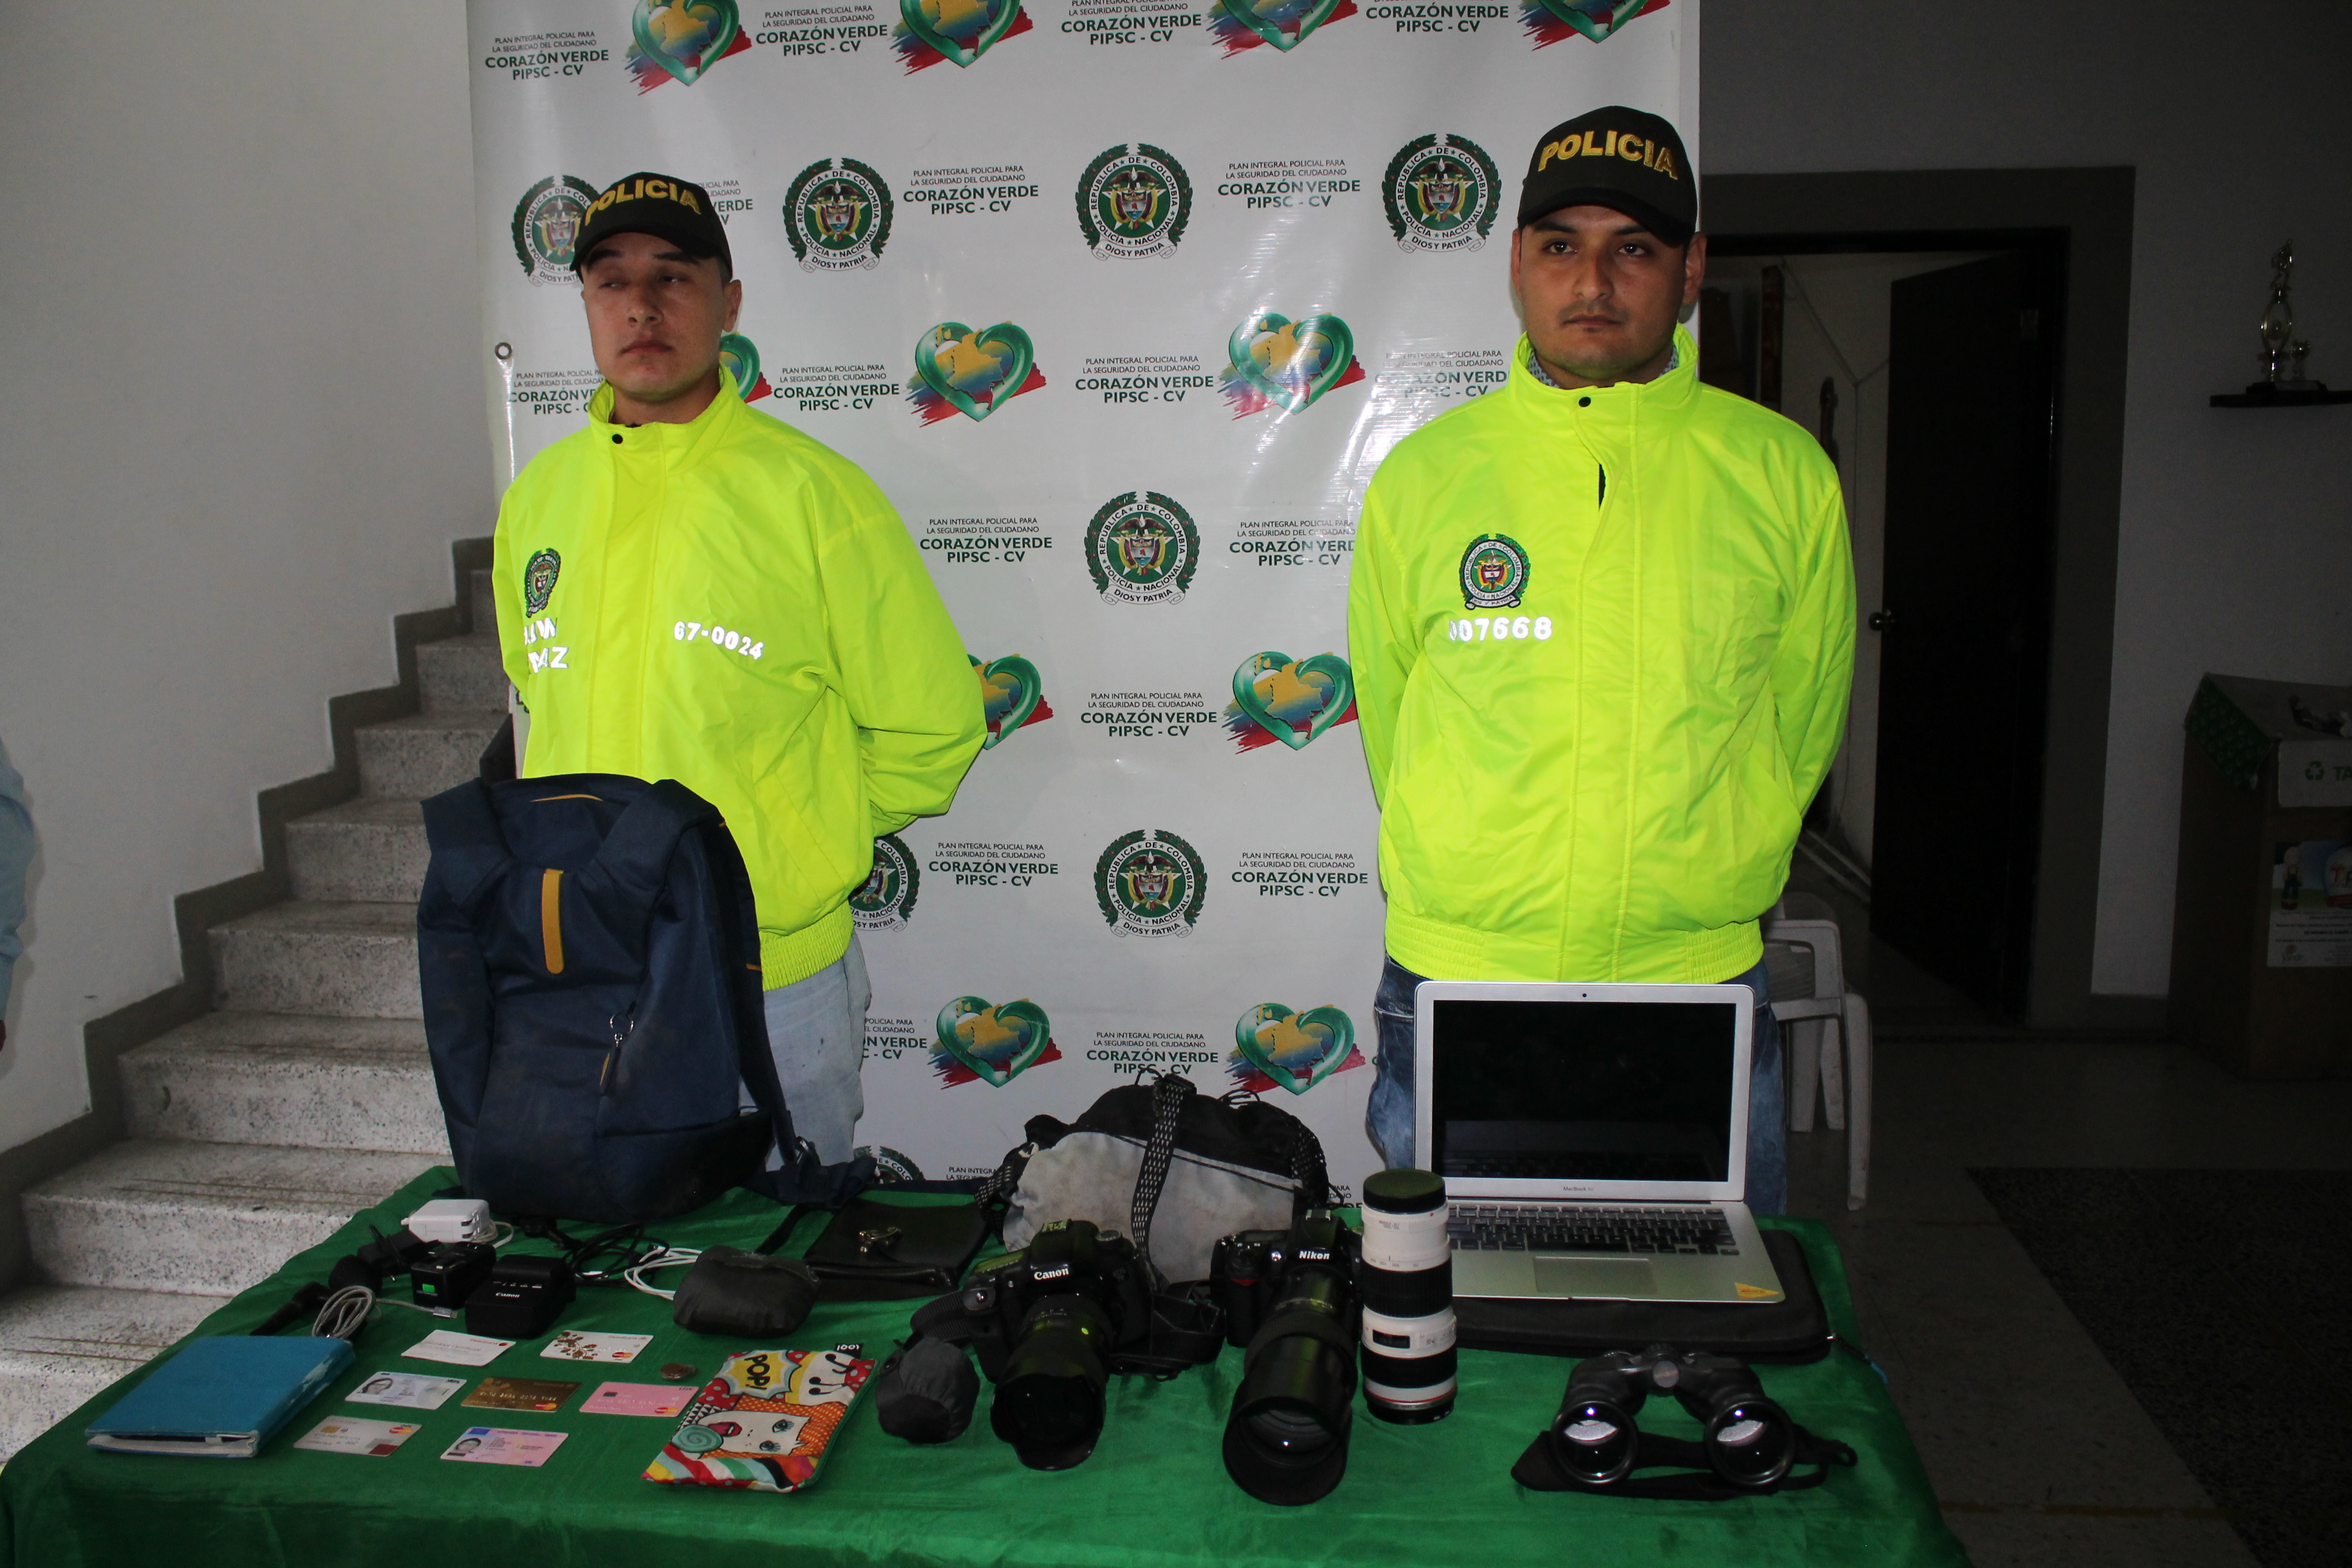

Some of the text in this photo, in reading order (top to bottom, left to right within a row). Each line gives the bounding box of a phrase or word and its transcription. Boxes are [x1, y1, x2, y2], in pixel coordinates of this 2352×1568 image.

[773, 18, 812, 26] SEGURIDAD
[830, 14, 874, 23] CIUDADANO
[514, 34, 547, 42] INTEGRAL
[756, 25, 887, 44] CORAZÓN VERDE
[503, 43, 538, 52] SEGURIDAD
[783, 42, 825, 56] PIPSC
[840, 40, 861, 52] CV
[486, 50, 608, 68] CORAZÓN VERDE
[513, 66, 550, 80] PIPSC
[563, 64, 583, 75] CV
[1538, 130, 1679, 180] POLICIA
[1150, 160, 1178, 208] COLOMBIA
[853, 174, 879, 220] COLOMBIA
[903, 186, 1038, 202] CORAZÓN VERDE
[585, 179, 701, 226] POLICIA
[932, 202, 974, 214] PIPSC
[989, 200, 1011, 212] CV
[1135, 243, 1164, 257] PATRIA
[840, 254, 868, 268] PATRIA
[1076, 374, 1213, 390] CORAZÓN VERDE
[774, 383, 899, 398] CORAZÓN VERDE
[1104, 391, 1148, 403] PIPSC
[1164, 390, 1185, 401] CV
[800, 400, 839, 411] PIPSC
[853, 399, 873, 409] CV
[921, 535, 1052, 549] CORAZÓN VERDE
[948, 552, 989, 562] PIPSC
[1004, 551, 1025, 562] CV
[1502, 545, 1521, 579] COLOMBIA
[674, 621, 765, 660] 67-0024
[1081, 710, 1217, 723] CORAZÓN VERDE
[1109, 726, 1153, 737] PIPSC
[1168, 726, 1189, 736] CV
[929, 859, 1058, 874] CORAZÓN VERDE
[1167, 847, 1193, 890] COLOMBIA
[956, 874, 997, 885] PIPSC
[1011, 876, 1032, 886] CV
[1232, 869, 1368, 883] CORAZÓN VERDE
[1260, 885, 1304, 896] PIPSC
[1319, 886, 1340, 896] CV
[1152, 923, 1180, 935] PATRIA
[1087, 1048, 1218, 1063] CORAZÓN VERDE
[1299, 1250, 1330, 1260] Nikon
[1034, 1267, 1069, 1280] Canon
[744, 1354, 770, 1390] POP!
